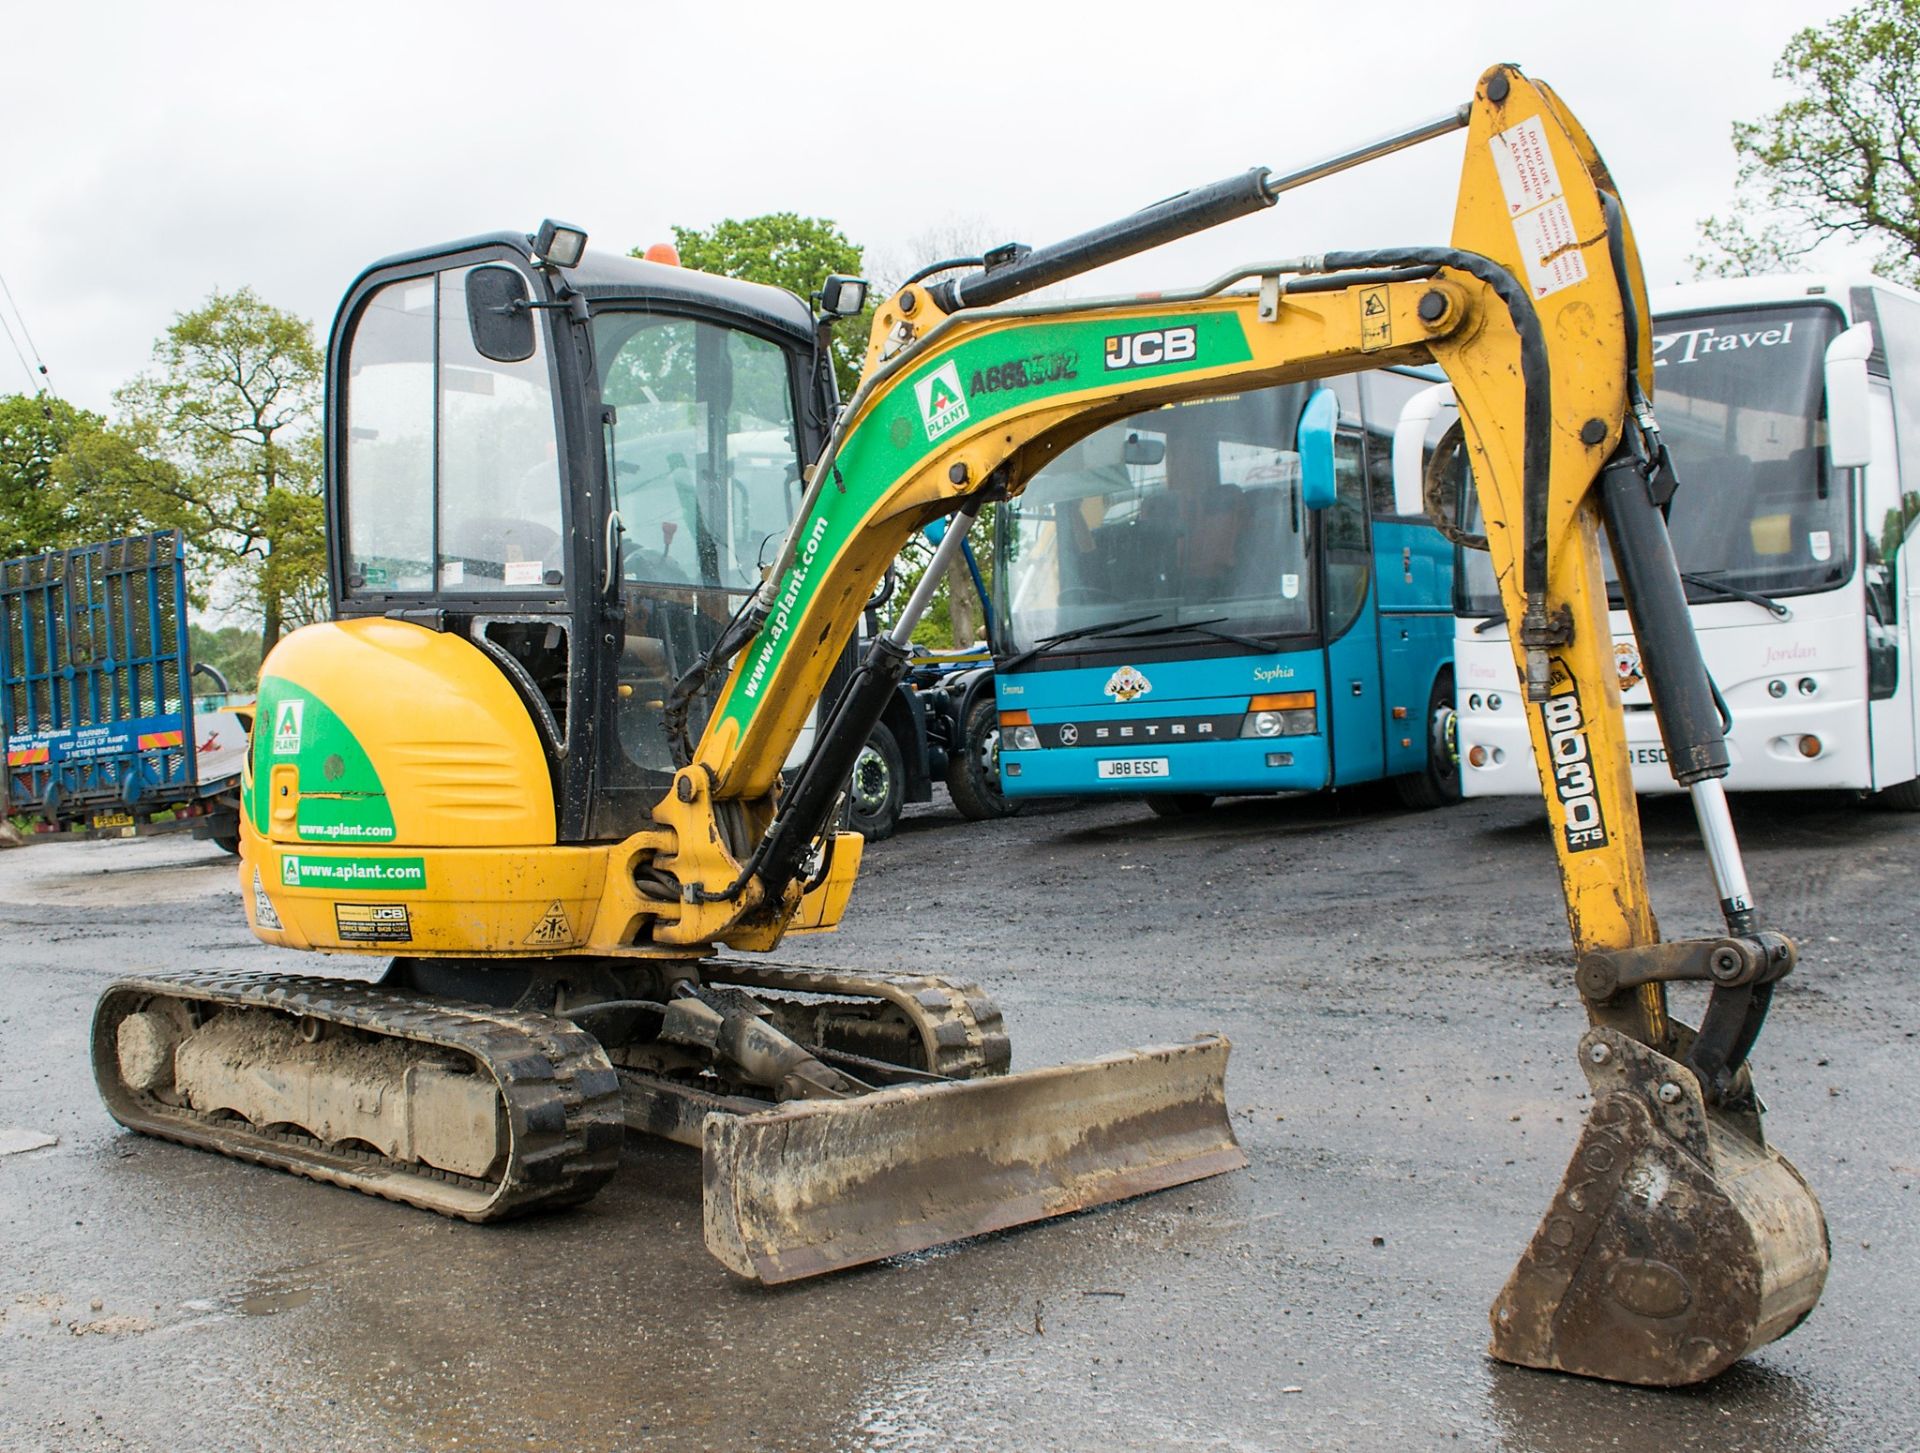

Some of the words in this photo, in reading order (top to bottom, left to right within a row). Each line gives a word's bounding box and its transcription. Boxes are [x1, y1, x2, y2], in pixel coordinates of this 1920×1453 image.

[1528, 131, 1539, 145] DO
[1516, 127, 1529, 146] THIS
[1523, 148, 1544, 200] EXCAVATOR
[1533, 147, 1545, 166] NOT
[1510, 142, 1519, 154] AS
[1517, 163, 1531, 192] CRANE
[1539, 168, 1551, 185] USE
[1106, 328, 1196, 368] JCB
[928, 404, 966, 436] PLANT
[744, 516, 828, 698] www.aplant.com
[1254, 664, 1294, 683] Sophia
[77, 727, 109, 738] WARNING
[1096, 723, 1212, 737] SETRA
[32, 740, 49, 749] Plant
[60, 741, 74, 750] KEEP
[76, 738, 96, 748] CLEAR
[97, 737, 105, 746] OF
[107, 735, 128, 744] RAMPS
[275, 739, 299, 751] PLANT
[72, 748, 95, 758] METRES
[1108, 762, 1131, 775] J88
[1134, 761, 1159, 774] ESC
[1544, 696, 1600, 831] 8030
[299, 823, 392, 838] www.aplant.com
[1569, 828, 1603, 844] ZTS
[301, 863, 421, 881] www.aplant.com
[373, 909, 404, 919] JCB
